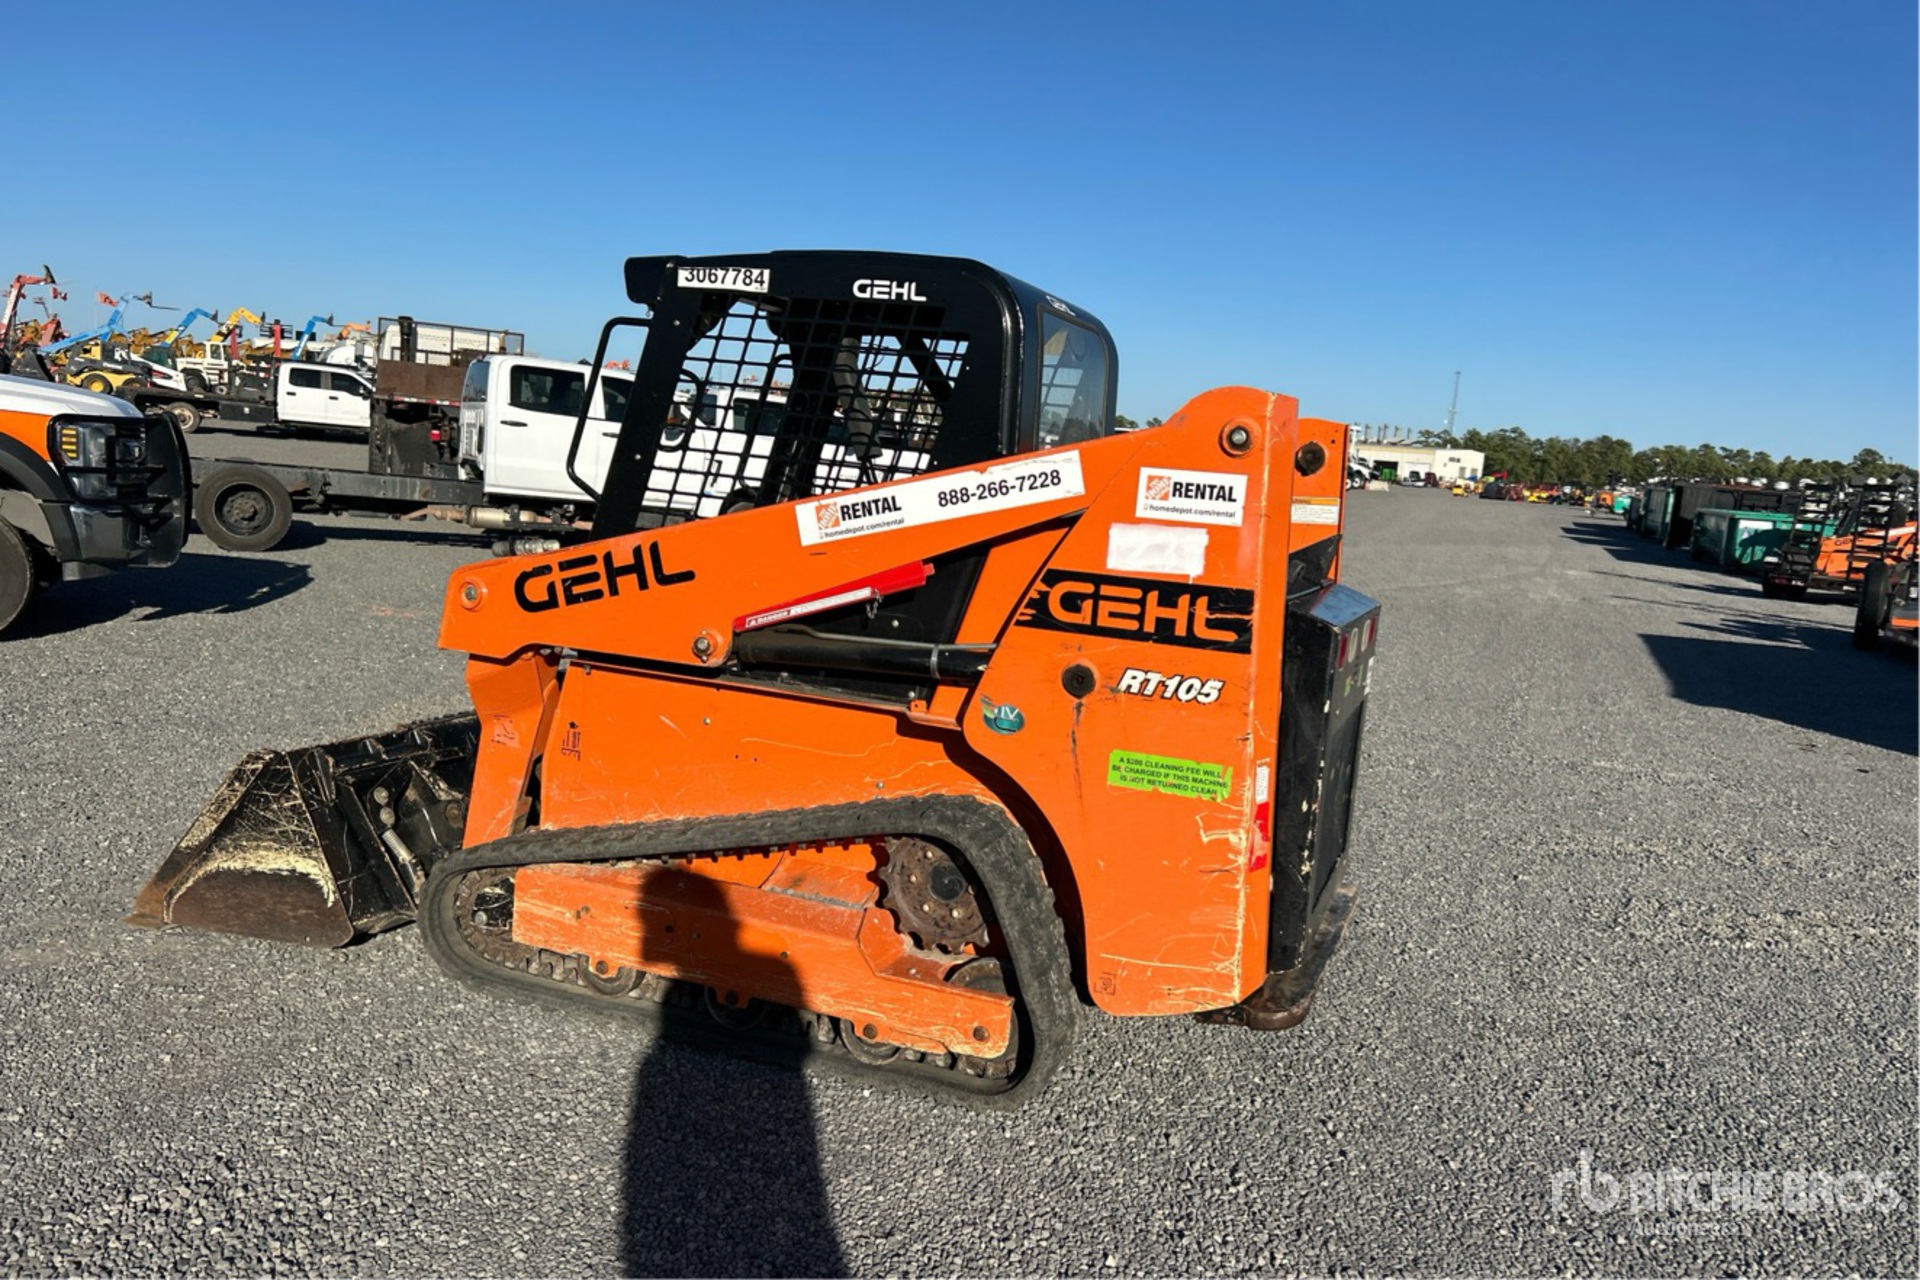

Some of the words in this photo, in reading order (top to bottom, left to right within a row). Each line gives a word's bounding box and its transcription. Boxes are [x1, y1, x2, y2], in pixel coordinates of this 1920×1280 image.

[685, 267, 766, 292] 3067784
[853, 279, 927, 302] GEHL
[938, 469, 1062, 508] 888-266-7228
[1172, 481, 1237, 503] RENTAL
[840, 496, 902, 521] RENTAL
[1149, 504, 1236, 518] homedepot.com/rental
[825, 518, 905, 538] homedepot.com/rental
[514, 541, 696, 613] GEHL
[1047, 580, 1239, 642] GEHL
[1118, 667, 1225, 704] RT105
[1124, 766, 1162, 778] CHARGED
[1173, 773, 1190, 783] THIS
[1144, 760, 1185, 773] CLEANING
[1186, 766, 1201, 776] FEE
